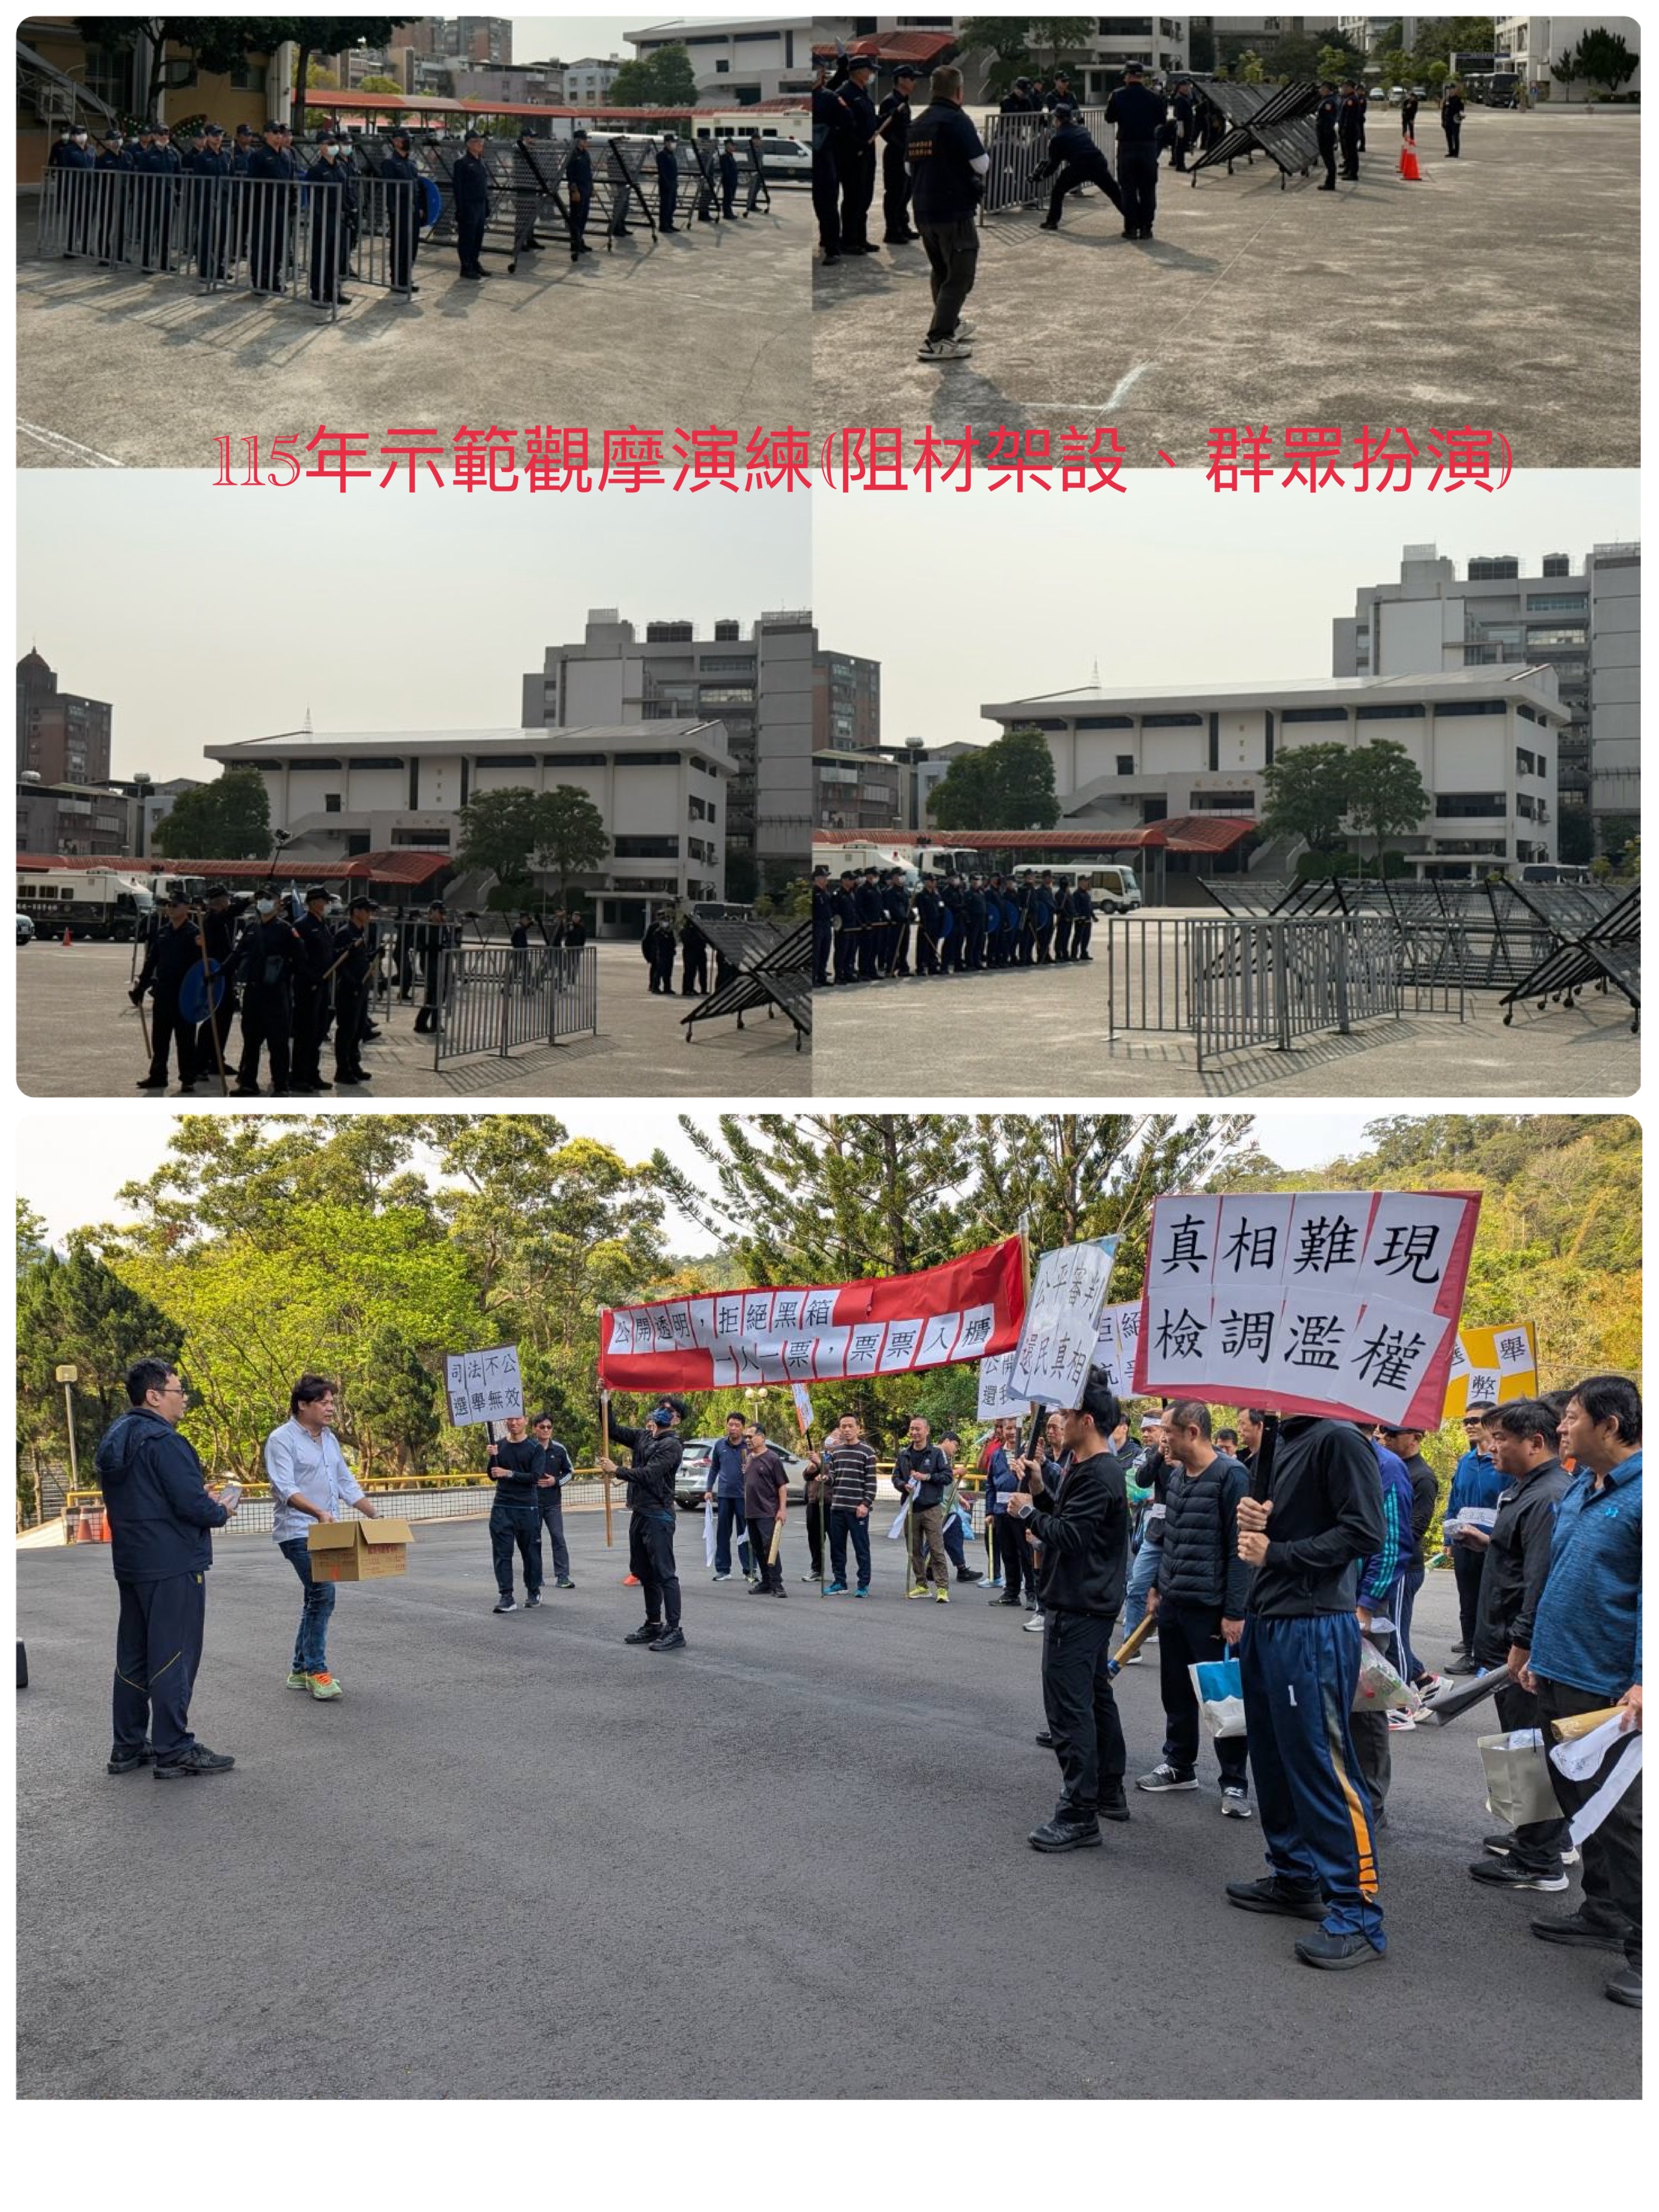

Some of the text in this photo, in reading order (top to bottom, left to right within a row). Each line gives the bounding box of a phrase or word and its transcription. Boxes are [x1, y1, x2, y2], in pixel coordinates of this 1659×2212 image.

[1161, 1213, 1440, 1284] 真相難現
[451, 1353, 516, 1382] 司法不公
[1154, 1308, 1427, 1391] 檢調濫權
[453, 1387, 521, 1417] 選舉無效
